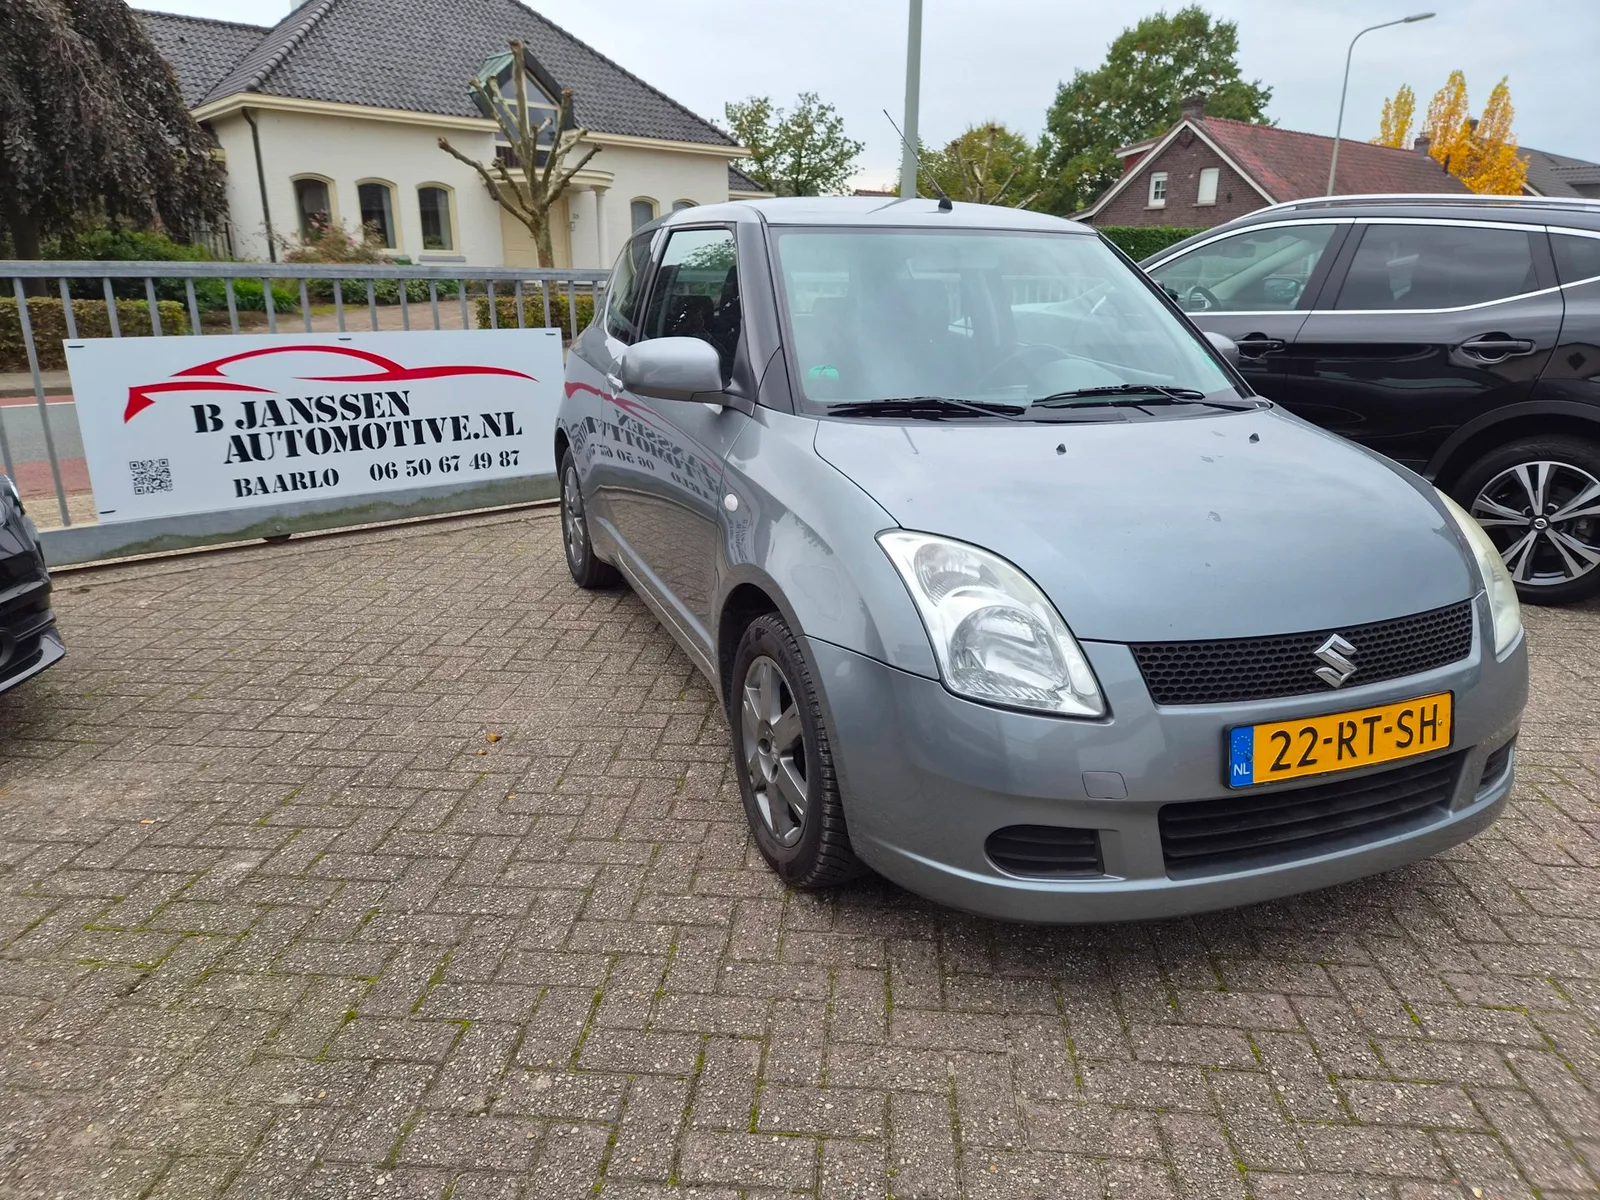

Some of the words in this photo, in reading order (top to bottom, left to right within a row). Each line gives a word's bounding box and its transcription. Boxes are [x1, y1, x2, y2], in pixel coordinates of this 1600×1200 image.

[190, 403, 224, 434] B
[234, 390, 411, 431] JANSSEN
[223, 411, 523, 466] AUTOMOTIVE.NL
[232, 468, 340, 498] BAARLO
[369, 463, 399, 482] 06
[404, 458, 433, 478] 50
[437, 455, 462, 475] 67
[468, 452, 494, 471] 49
[498, 449, 520, 469] 87
[1270, 703, 1438, 772] 22-RT-SH
[1233, 762, 1251, 777] NL
